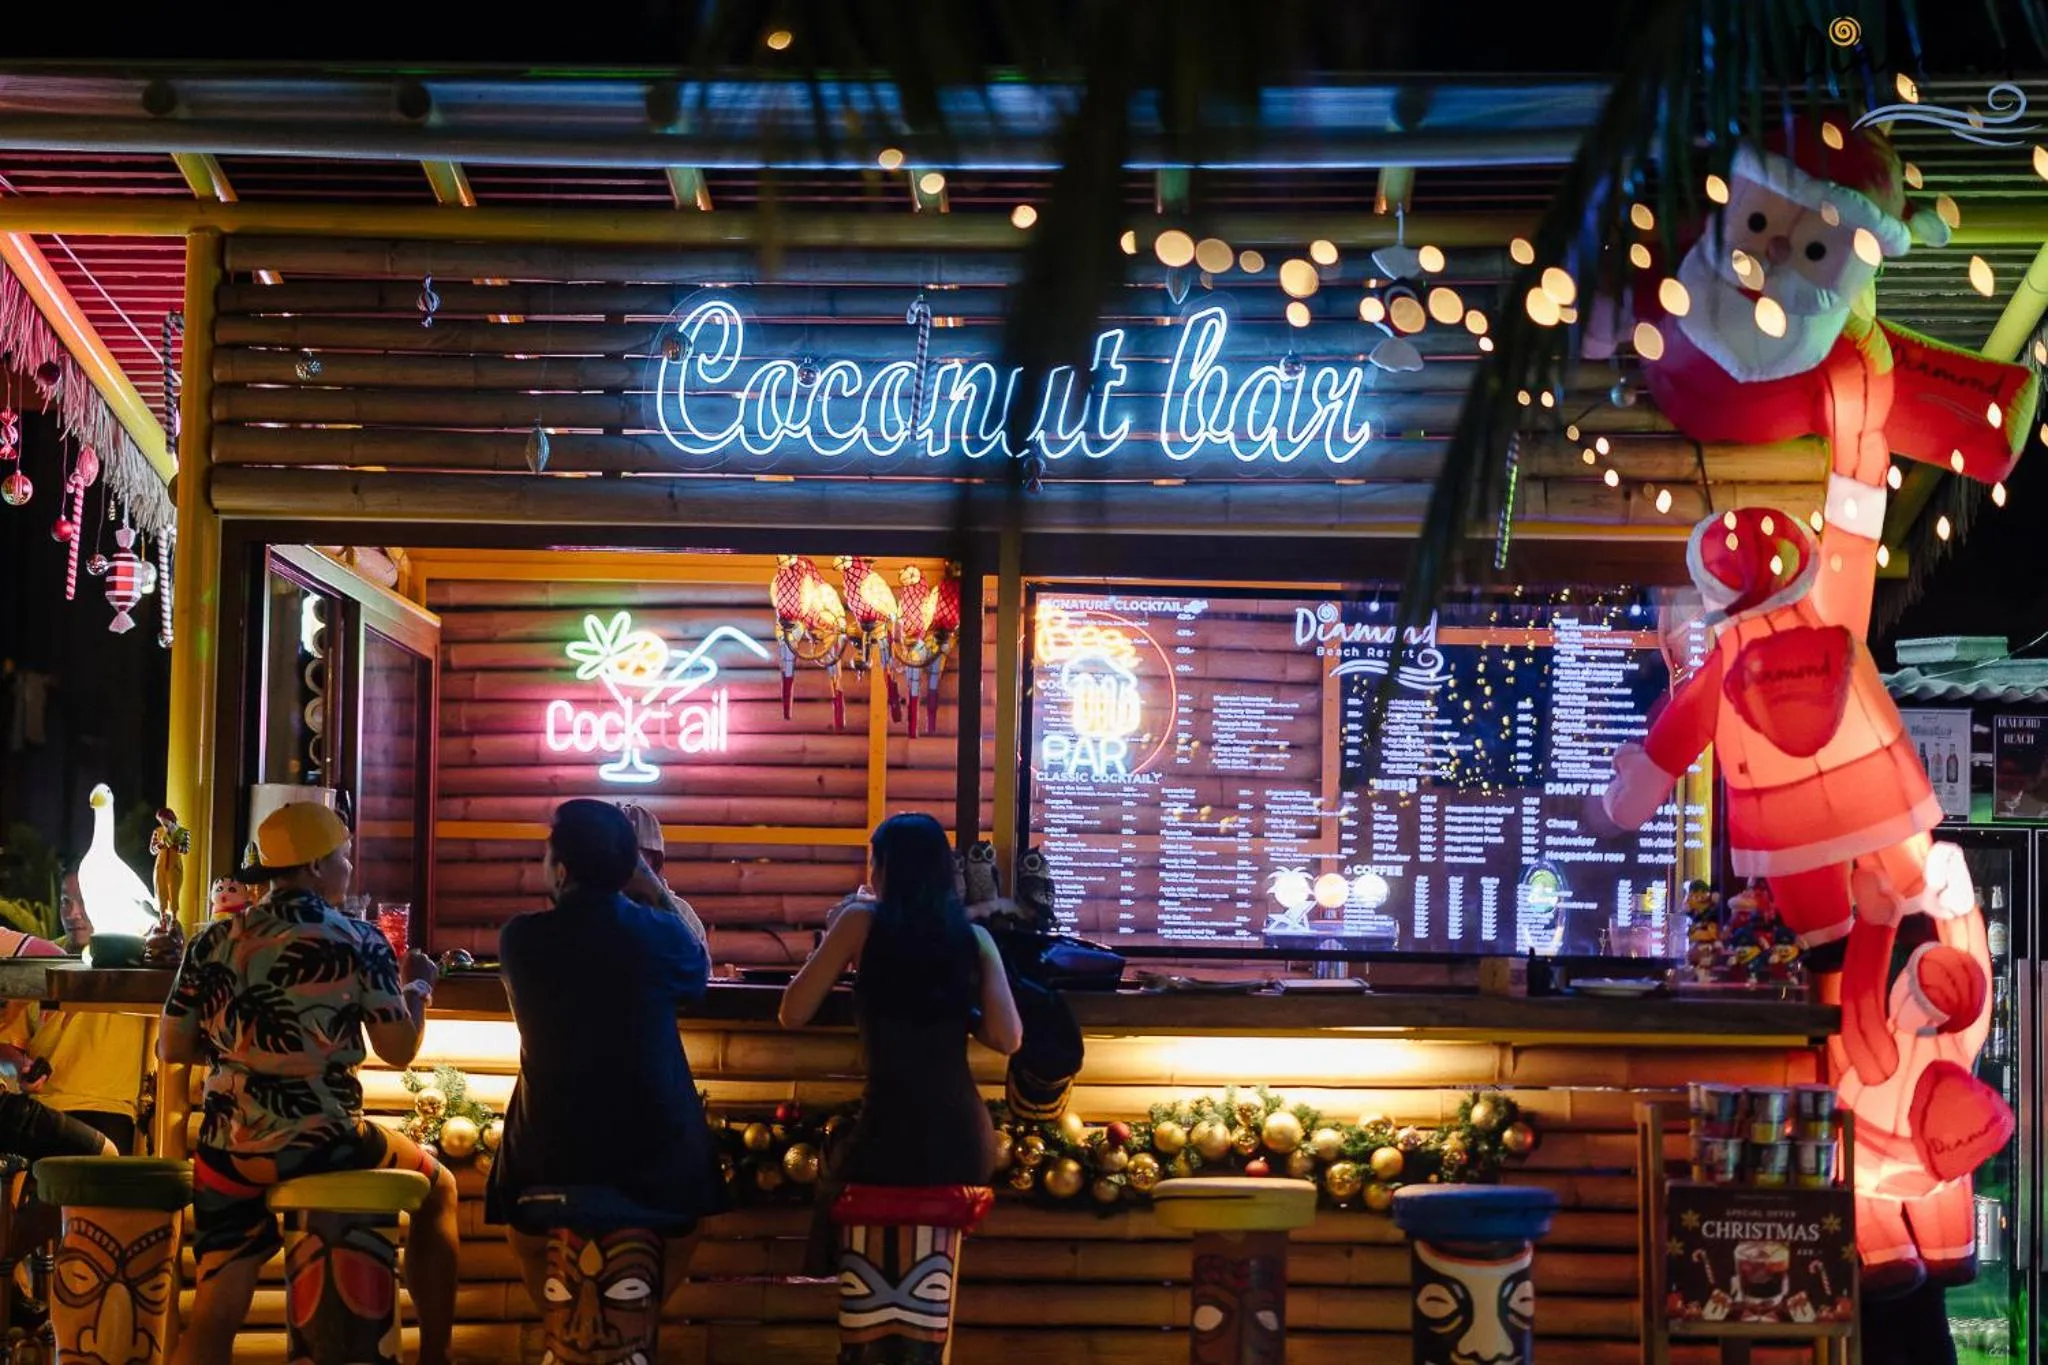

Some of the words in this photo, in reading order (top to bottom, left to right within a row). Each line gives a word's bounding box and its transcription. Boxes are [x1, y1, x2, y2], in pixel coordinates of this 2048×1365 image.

[657, 301, 1131, 459] Coconut
[1160, 306, 1371, 464] bar
[1316, 646, 1359, 657] Beach
[1367, 647, 1415, 658] Resrt
[546, 688, 728, 754] Cocktail
[2003, 733, 2034, 745] BEACH
[1041, 734, 1128, 775] BAR
[1036, 771, 1088, 782] CLASSIC
[1545, 783, 1587, 795] DRAFT
[1546, 818, 1578, 831] Chang
[1352, 864, 1403, 877] COFFEE
[1702, 1220, 1820, 1242] CHRISTMAS
